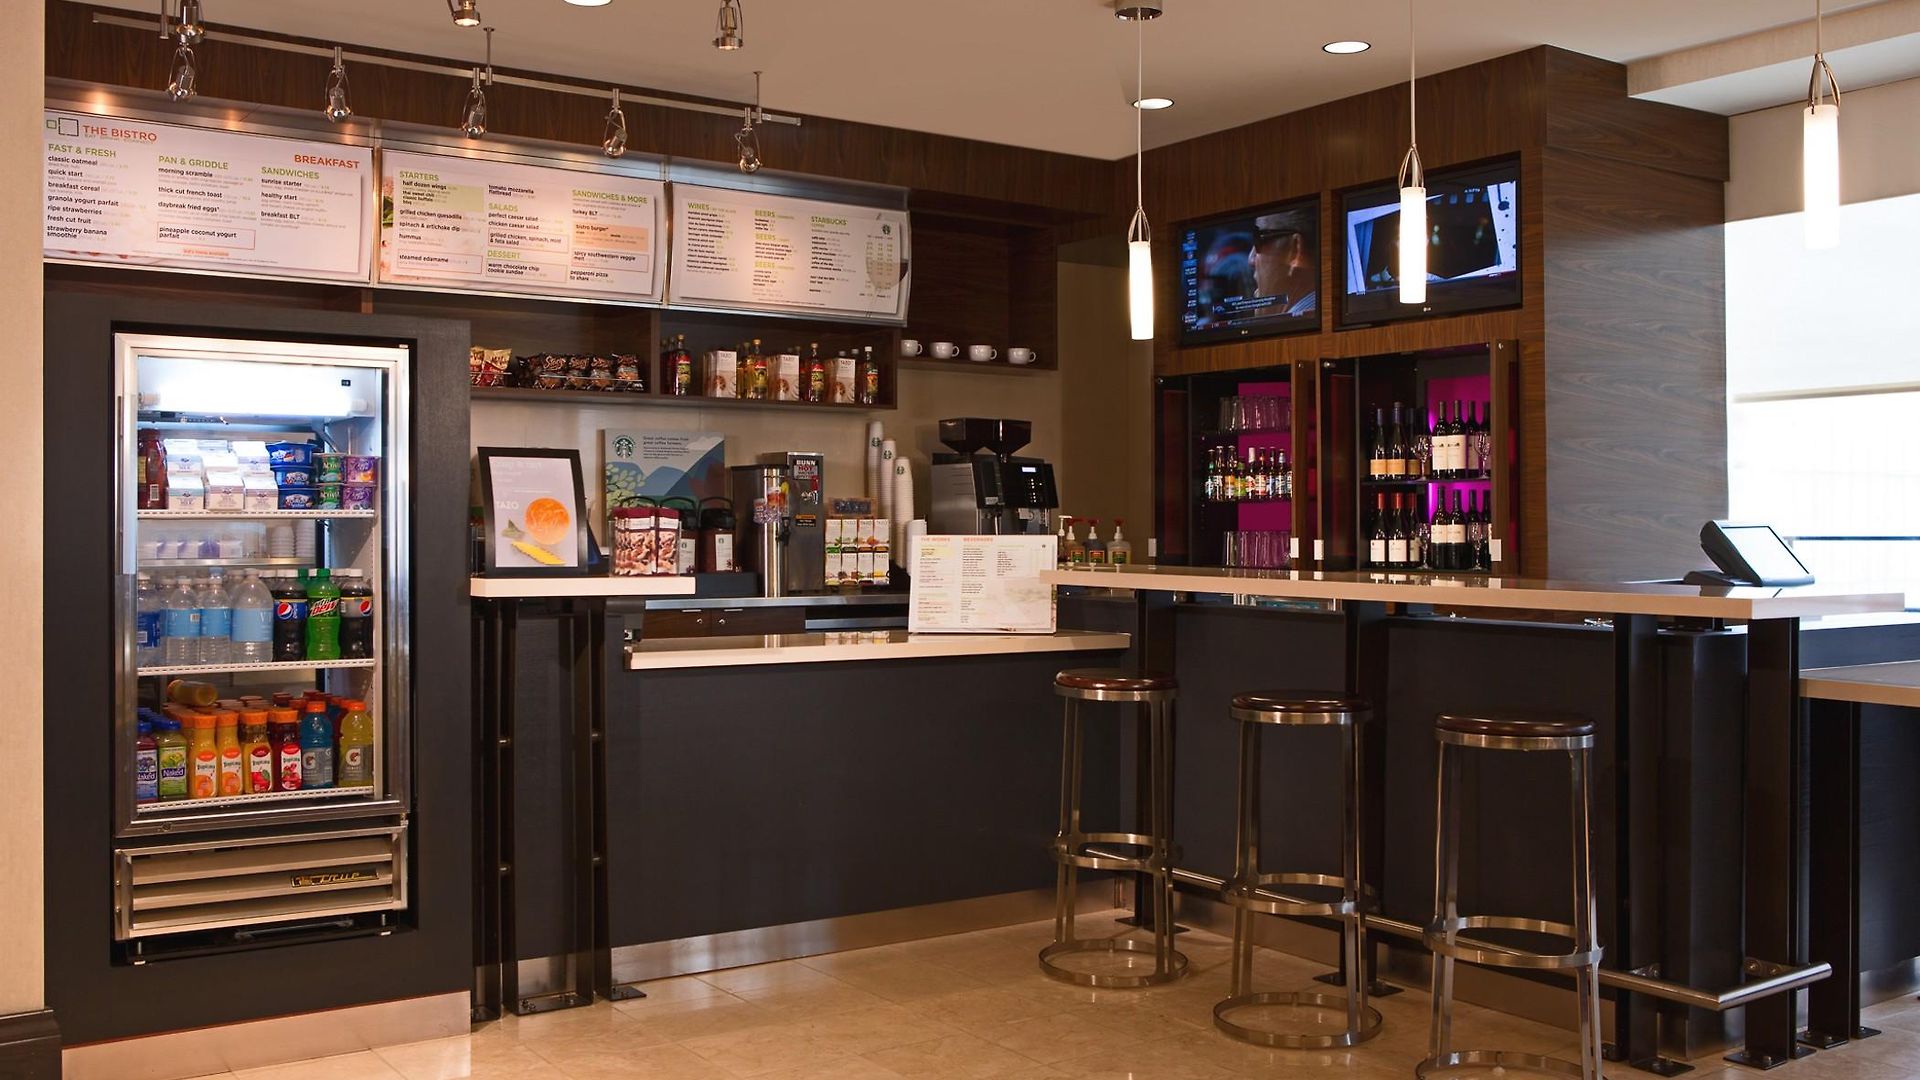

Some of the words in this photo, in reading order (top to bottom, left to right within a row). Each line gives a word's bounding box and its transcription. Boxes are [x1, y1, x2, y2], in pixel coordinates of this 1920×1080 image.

[83, 125, 108, 136] THE
[112, 128, 157, 142] BISTRO
[48, 144, 73, 153] FAST
[85, 148, 116, 157] FRESH
[189, 159, 228, 169] GRIDDLE
[294, 154, 360, 169] BREAKFAST
[261, 167, 319, 179] SANDWICHES
[400, 171, 439, 181] STARTERS
[572, 190, 620, 201] SANDWICHES
[628, 195, 647, 204] MORE
[62, 206, 102, 215] strawberries
[488, 203, 518, 212] SALADS
[811, 216, 847, 225] STARBUCKS
[47, 225, 82, 234] strawberry
[488, 250, 520, 258] DESSERT
[163, 768, 184, 777] Naked
